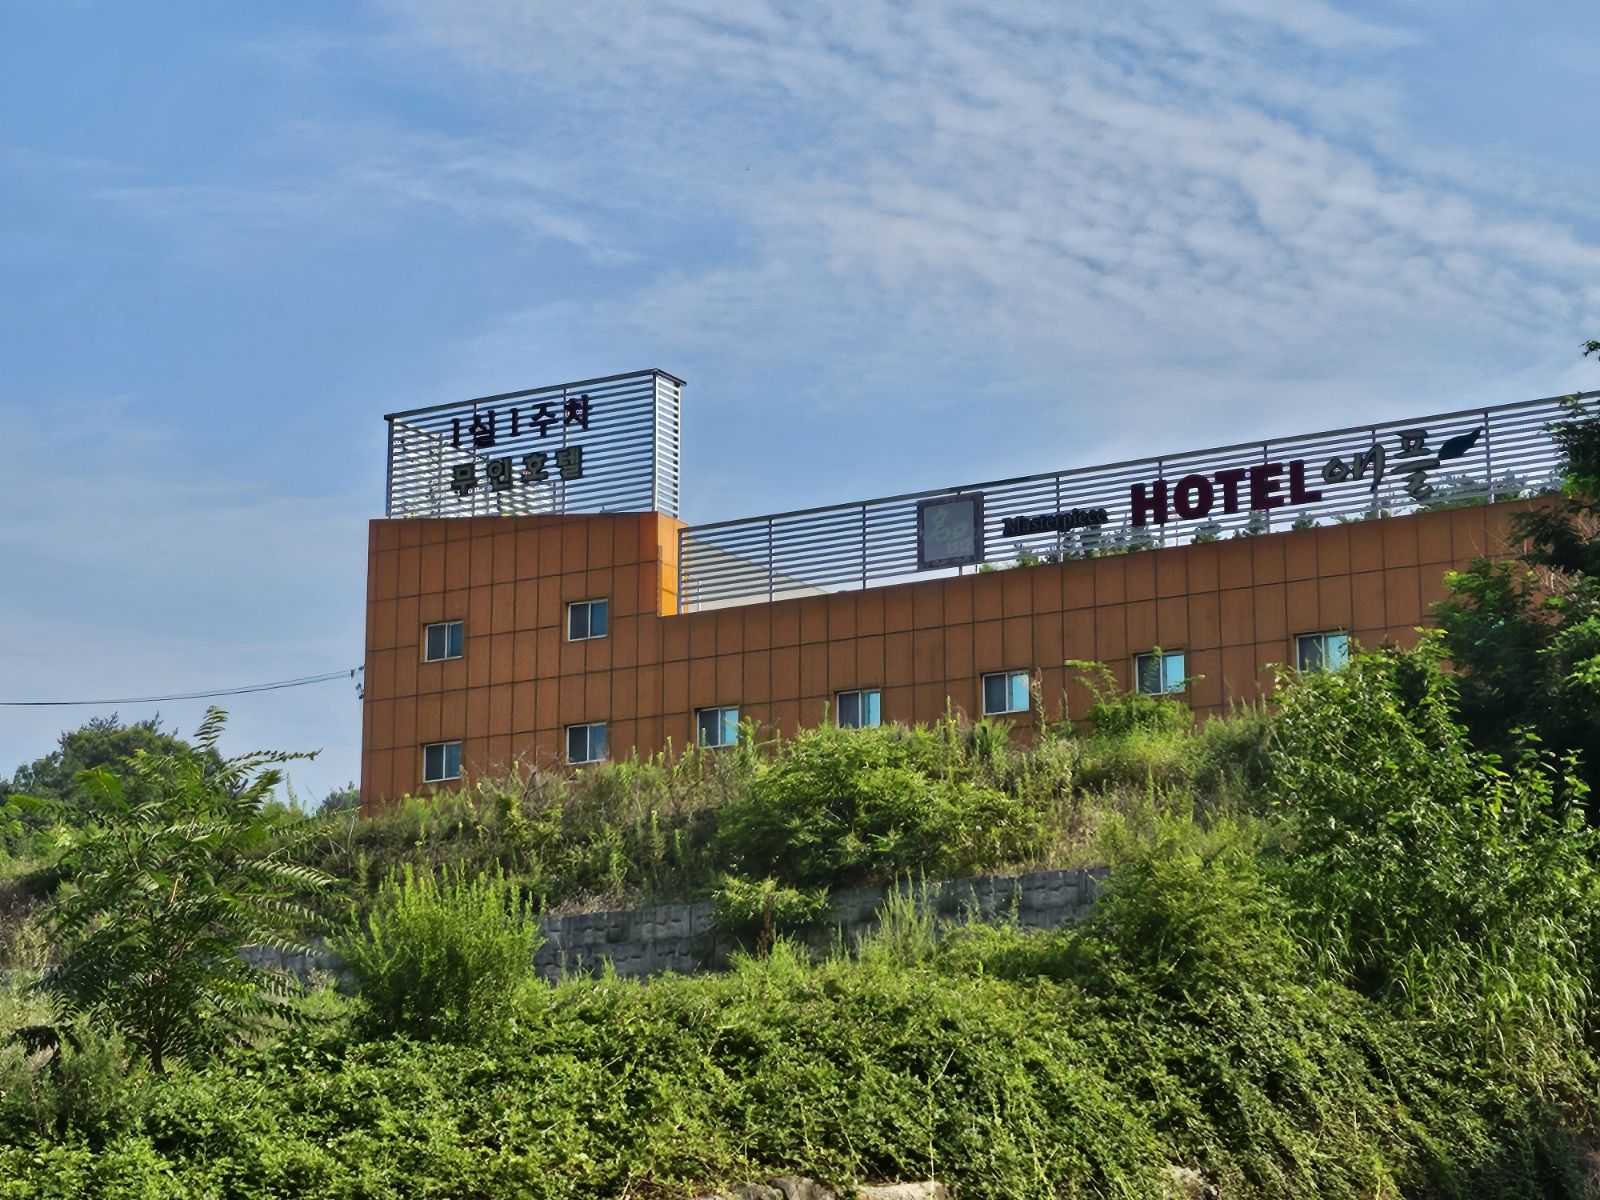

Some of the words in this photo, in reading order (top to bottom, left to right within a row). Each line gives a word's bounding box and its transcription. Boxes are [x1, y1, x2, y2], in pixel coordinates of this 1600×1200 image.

[451, 445, 583, 496] 무인호텔
[1130, 459, 1322, 527] HOTEL
[1001, 507, 1109, 537] Masterpiece
